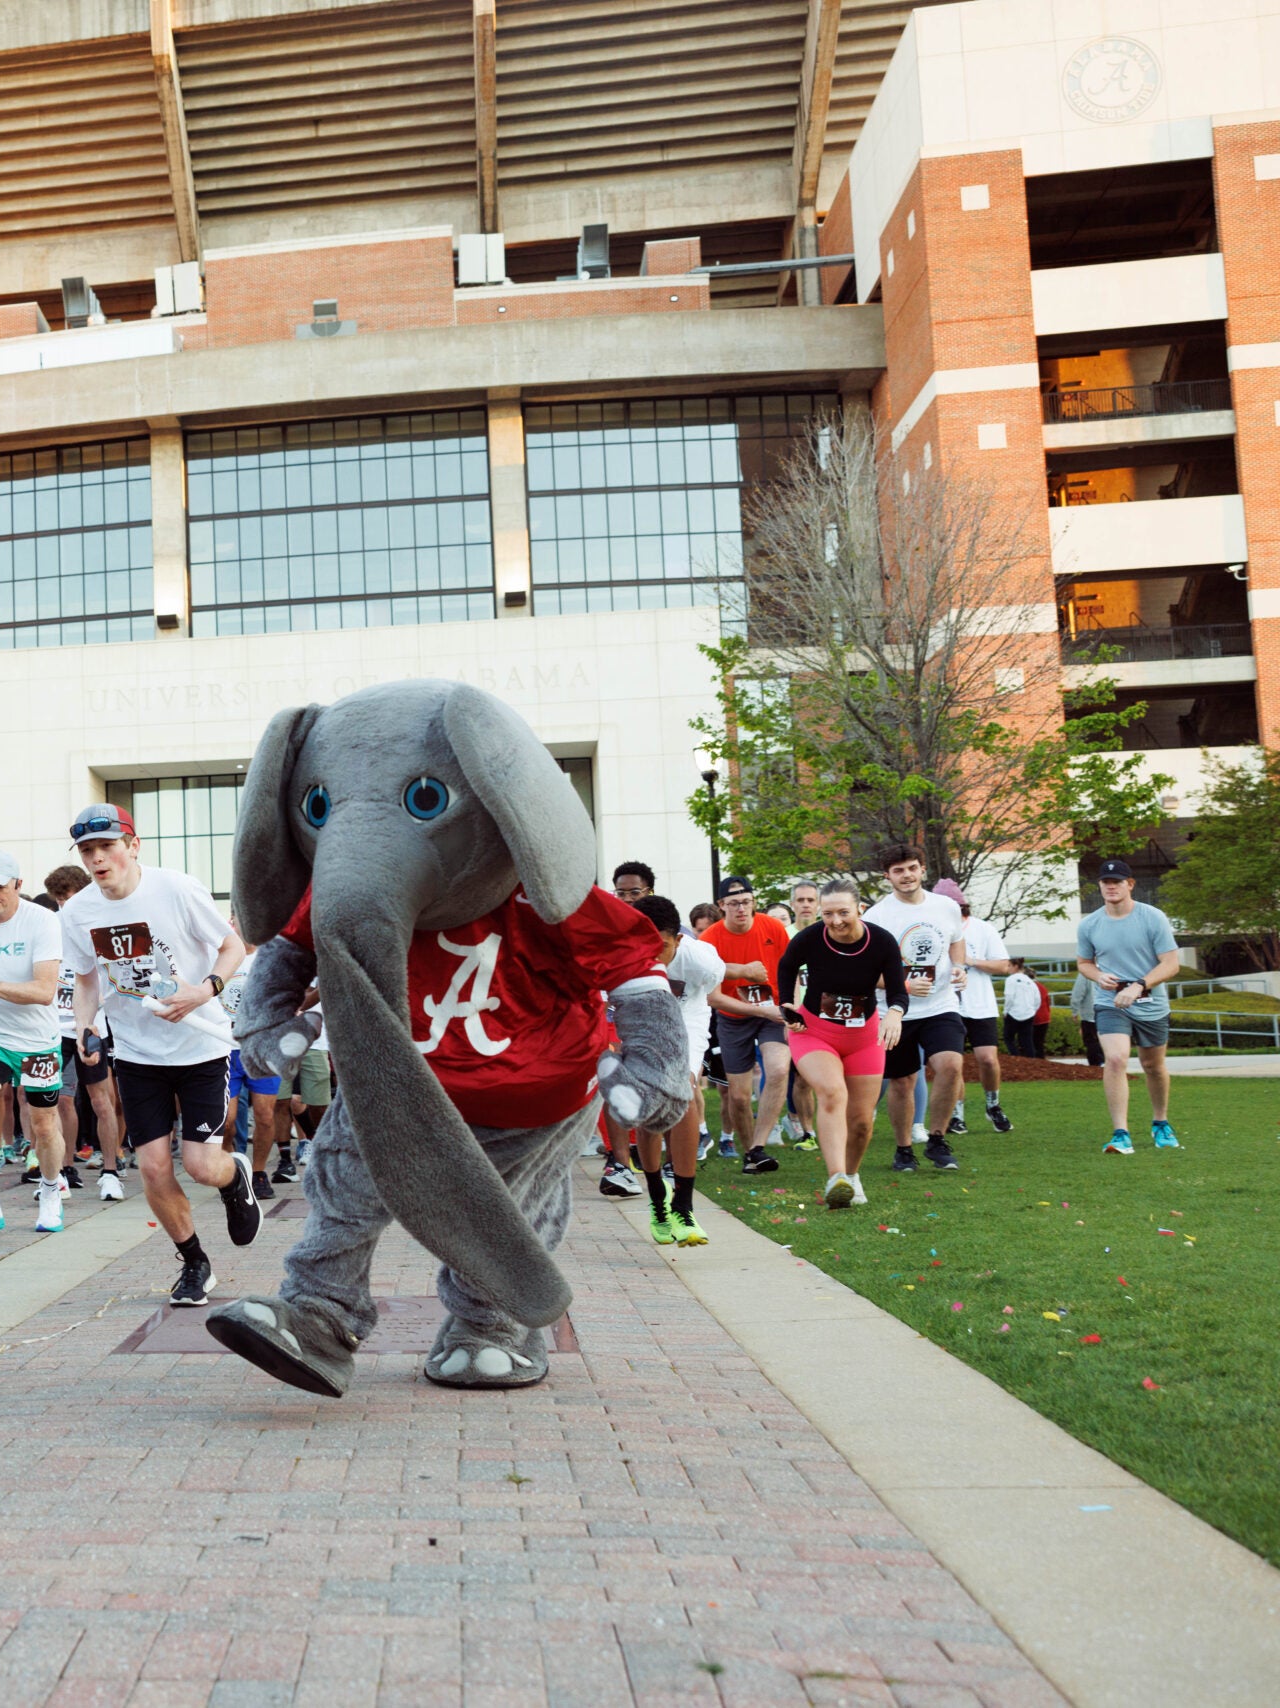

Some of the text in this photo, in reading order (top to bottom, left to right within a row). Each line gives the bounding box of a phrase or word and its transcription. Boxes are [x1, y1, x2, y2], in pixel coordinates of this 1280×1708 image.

[88, 677, 312, 712] UNIVERSITY
[111, 934, 132, 957] 87
[916, 945, 932, 956] 5K
[413, 931, 512, 1056] A
[748, 989, 761, 1003] 41
[834, 1002, 853, 1018] 23
[31, 1061, 54, 1077] 428
